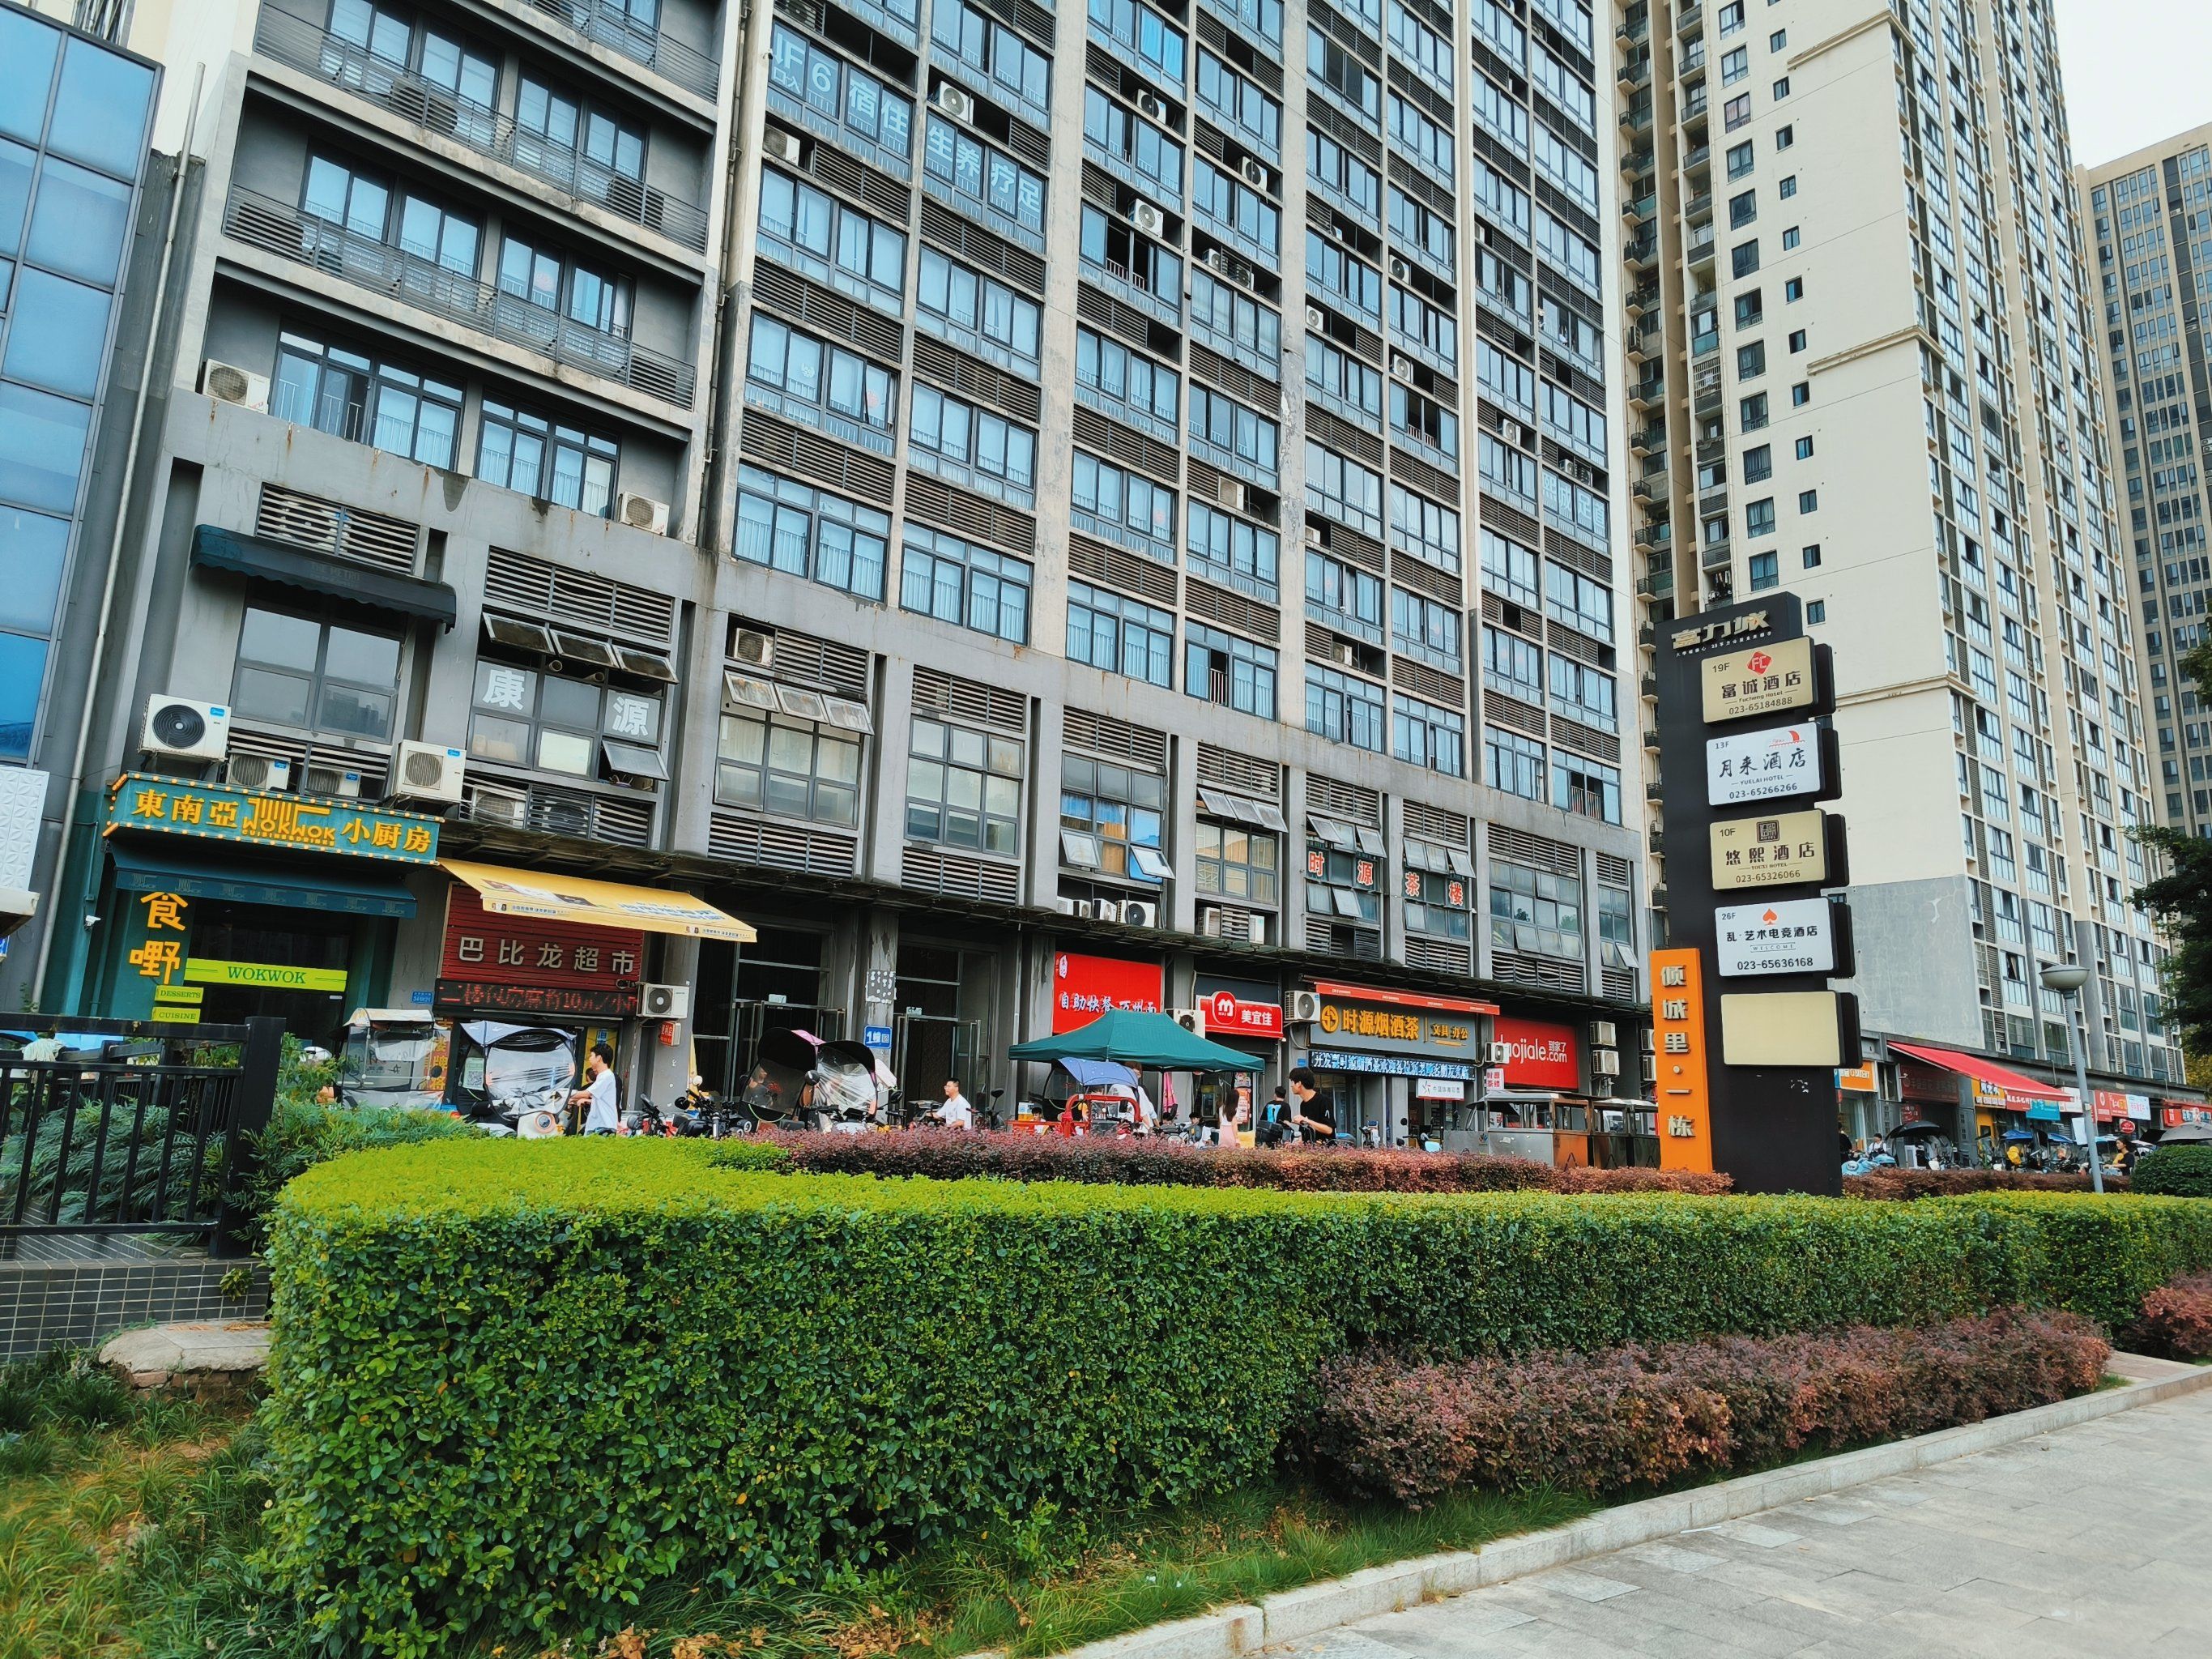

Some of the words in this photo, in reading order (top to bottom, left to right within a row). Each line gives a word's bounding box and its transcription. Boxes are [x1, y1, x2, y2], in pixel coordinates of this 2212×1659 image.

[1671, 610, 1771, 650] 富力城
[1712, 662, 1730, 673] 19F
[1721, 671, 1801, 699] 富诚酒店
[1728, 697, 1792, 715] 023-65184888
[1715, 741, 1729, 750] 13F
[1719, 747, 1806, 778] 月来酒店
[1764, 775, 1784, 783] HOTEL
[1729, 783, 1797, 800] 023-65266266
[131, 788, 239, 828] 東南亞
[242, 815, 336, 840] WOKWOK
[341, 817, 432, 853] 小厨房
[1720, 828, 1736, 837] 10F
[1725, 842, 1815, 866] 悠熙酒店
[1736, 870, 1801, 884] 023-65326066
[1721, 911, 1737, 921] 26F
[459, 936, 635, 975] 巴比龙超市
[1737, 957, 1813, 970] 023-65636168
[227, 966, 307, 984] WOKWOK
[160, 990, 202, 999] DESSERTS
[1061, 992, 1114, 1013] 自助快餐
[159, 1012, 197, 1021] CUISINE
[1241, 1009, 1272, 1026] 美宜佳
[1341, 1009, 1419, 1041] 时源烟酒茶
[1432, 1024, 1449, 1038] 文具
[1451, 1026, 1469, 1040] 办公
[1548, 1040, 1566, 1053] 到家了
